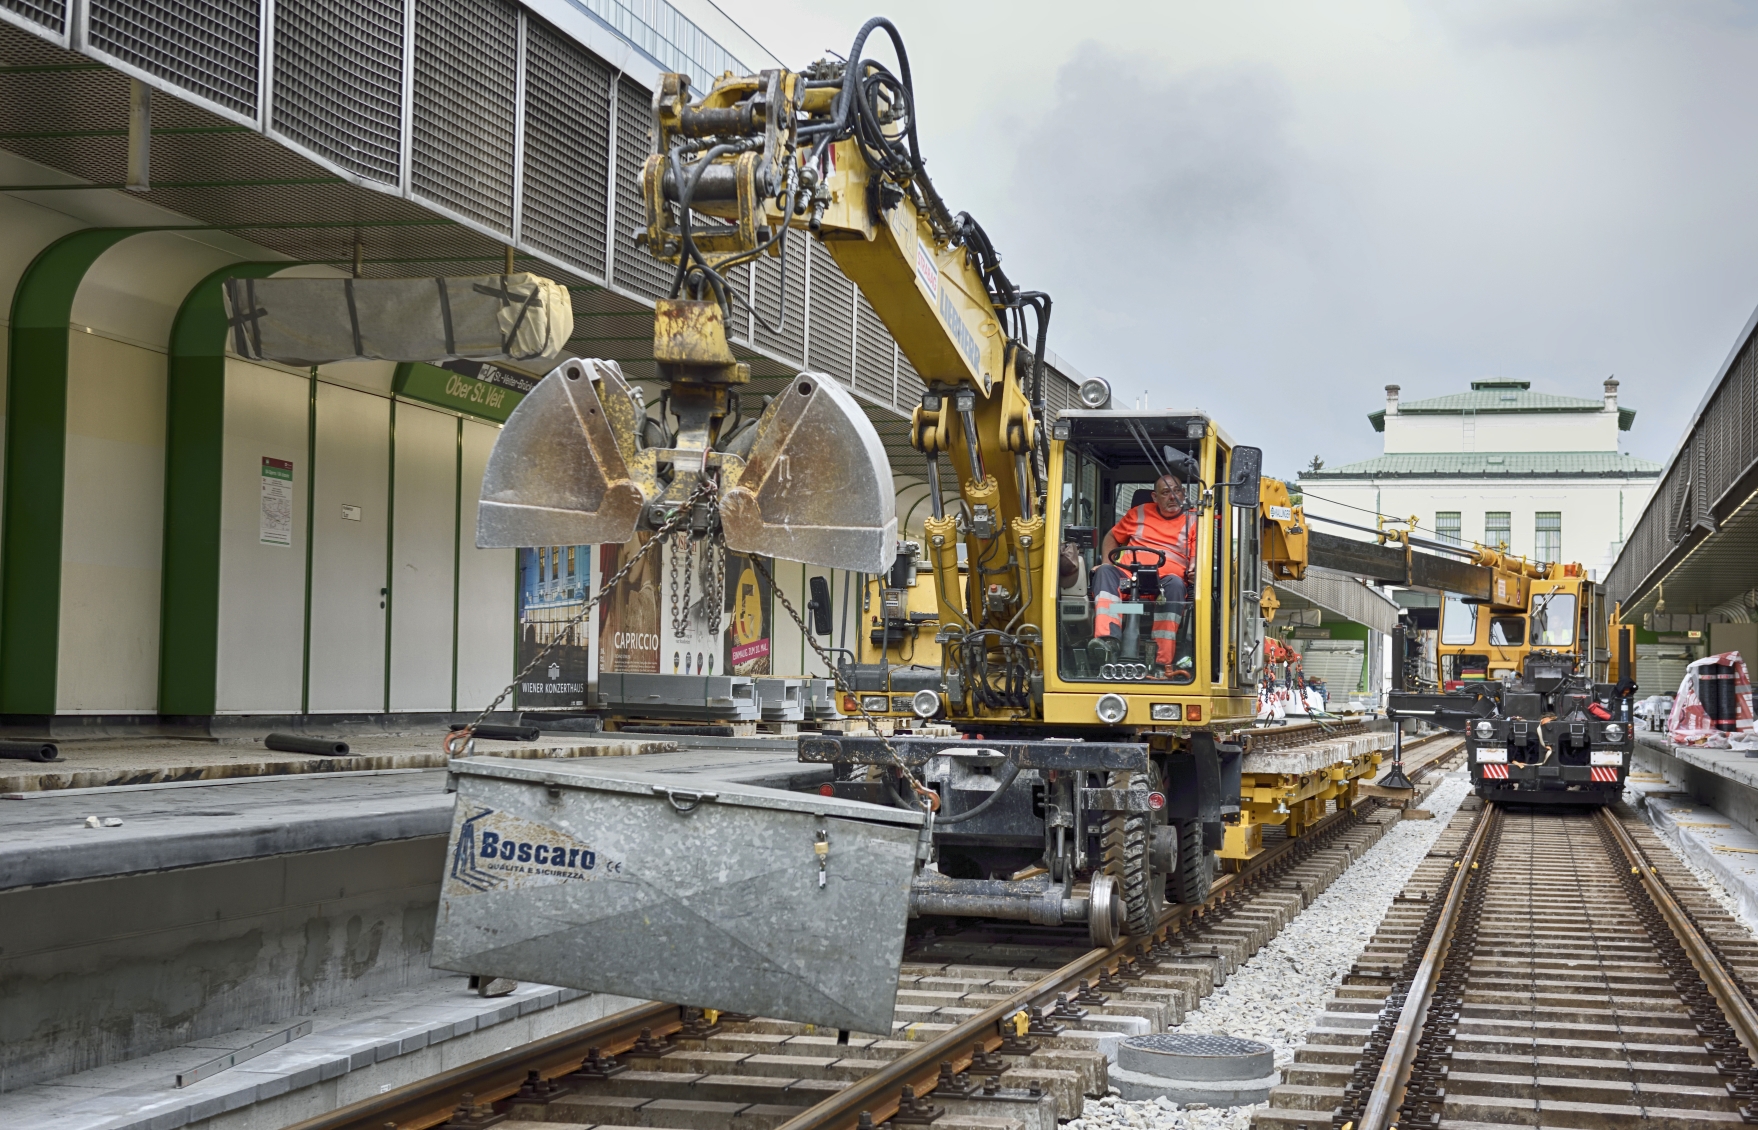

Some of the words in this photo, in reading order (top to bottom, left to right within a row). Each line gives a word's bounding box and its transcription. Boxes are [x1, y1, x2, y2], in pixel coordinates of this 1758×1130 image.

[917, 250, 937, 292] STRABAG
[939, 286, 981, 376] LIEBHERR
[445, 374, 472, 398] Ober
[470, 382, 485, 404] St.
[485, 386, 506, 409] Veit
[494, 371, 536, 392] St.-Veiter-Brück
[614, 631, 659, 651] CAPRICCIO
[522, 682, 544, 693] WIENER
[545, 683, 584, 694] KONZERTHAUS
[480, 831, 596, 870] Boscaro
[535, 868, 585, 880] SICUREZZA
